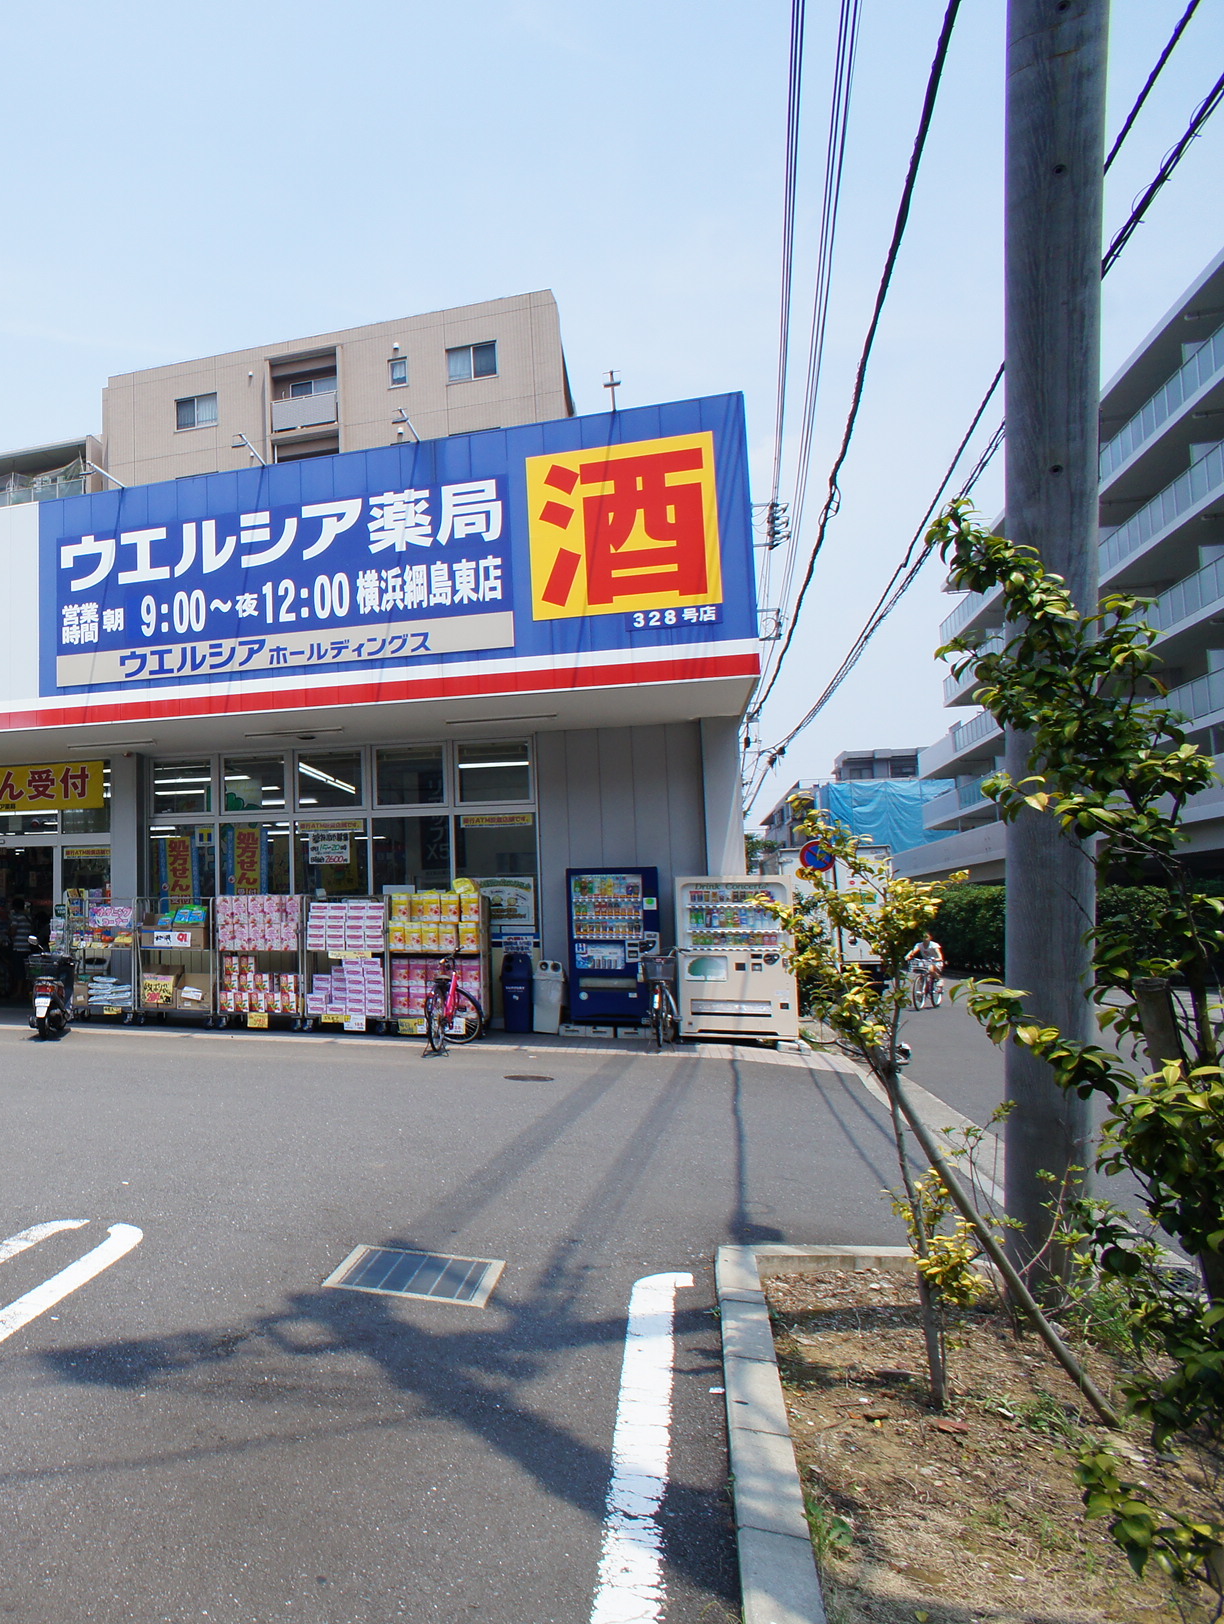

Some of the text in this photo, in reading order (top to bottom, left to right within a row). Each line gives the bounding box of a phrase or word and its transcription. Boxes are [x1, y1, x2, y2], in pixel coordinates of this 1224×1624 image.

[60, 479, 502, 592] ウエルシア薬局
[539, 447, 708, 607] 酒
[356, 556, 502, 614] 横浜綱島東店
[102, 607, 124, 632] 朝
[633, 606, 716, 628] 328号店
[168, 840, 190, 892] 処方せん
[237, 832, 258, 885] 処方せん
